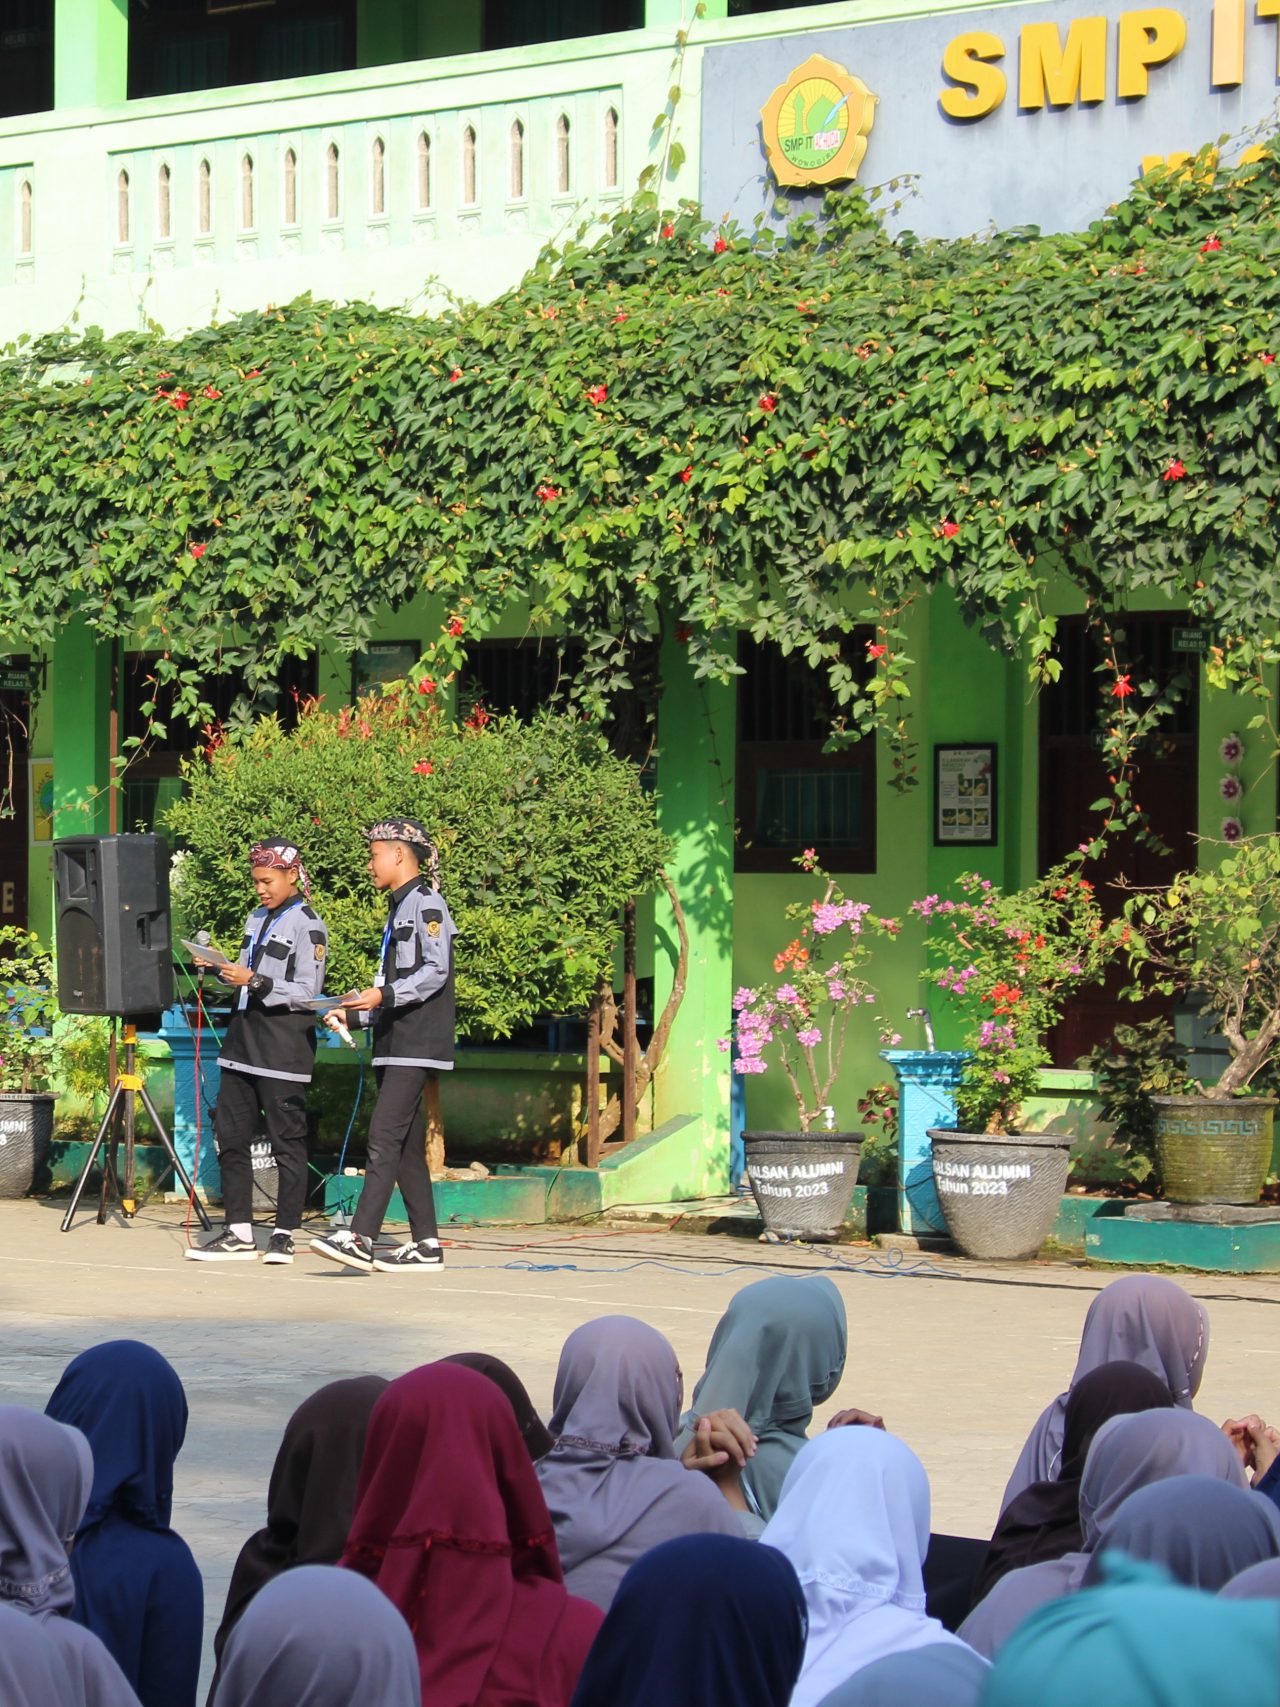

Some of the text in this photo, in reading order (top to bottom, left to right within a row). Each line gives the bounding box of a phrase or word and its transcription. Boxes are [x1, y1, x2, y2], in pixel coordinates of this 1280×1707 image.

[939, 7, 1187, 118] SMP
[784, 138, 804, 152] SMP
[805, 136, 813, 150] IT
[791, 1161, 843, 1179] ALUMNI
[972, 1164, 1031, 1179] ALUMNI
[754, 1179, 829, 1198] Tahun 2023
[936, 1175, 1008, 1195] Tahun 2023
